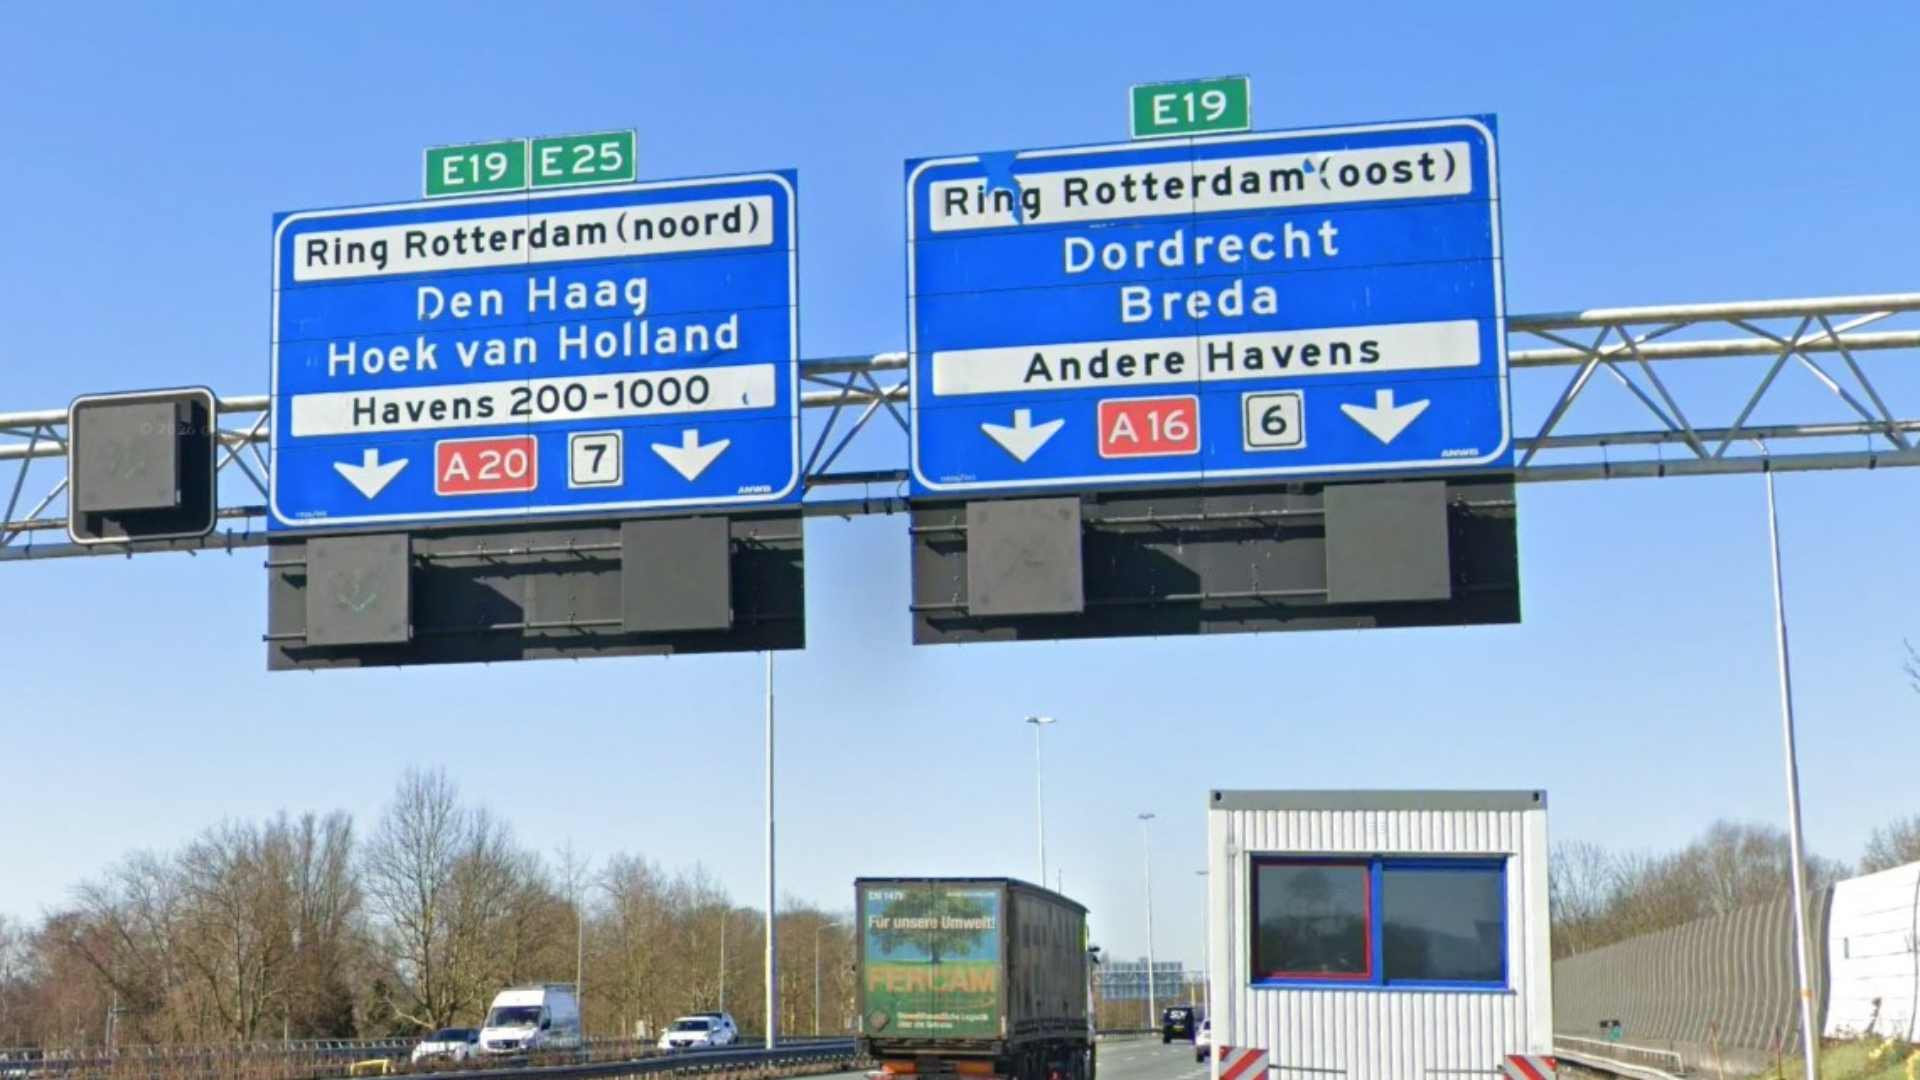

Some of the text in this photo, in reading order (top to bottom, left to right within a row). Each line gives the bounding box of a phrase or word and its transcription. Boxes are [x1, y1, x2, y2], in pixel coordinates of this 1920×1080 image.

[1152, 90, 1227, 125] E19
[442, 152, 508, 185] E19
[944, 148, 1456, 220] Ring Rotterdam (oost)
[306, 237, 388, 271] Ring
[1064, 221, 1339, 274] Dordrecht
[417, 277, 648, 320] Den Haag
[1121, 280, 1278, 322] Breda
[328, 314, 738, 376] Hoek van Holland
[1023, 339, 1380, 383] Andere Havens
[352, 374, 710, 426] Havens 200-1000
[1260, 404, 1288, 436] 6
[583, 443, 608, 474] 7
[868, 915, 889, 929] Für
[892, 917, 938, 930] unsere
[868, 965, 996, 993] FERCAM
